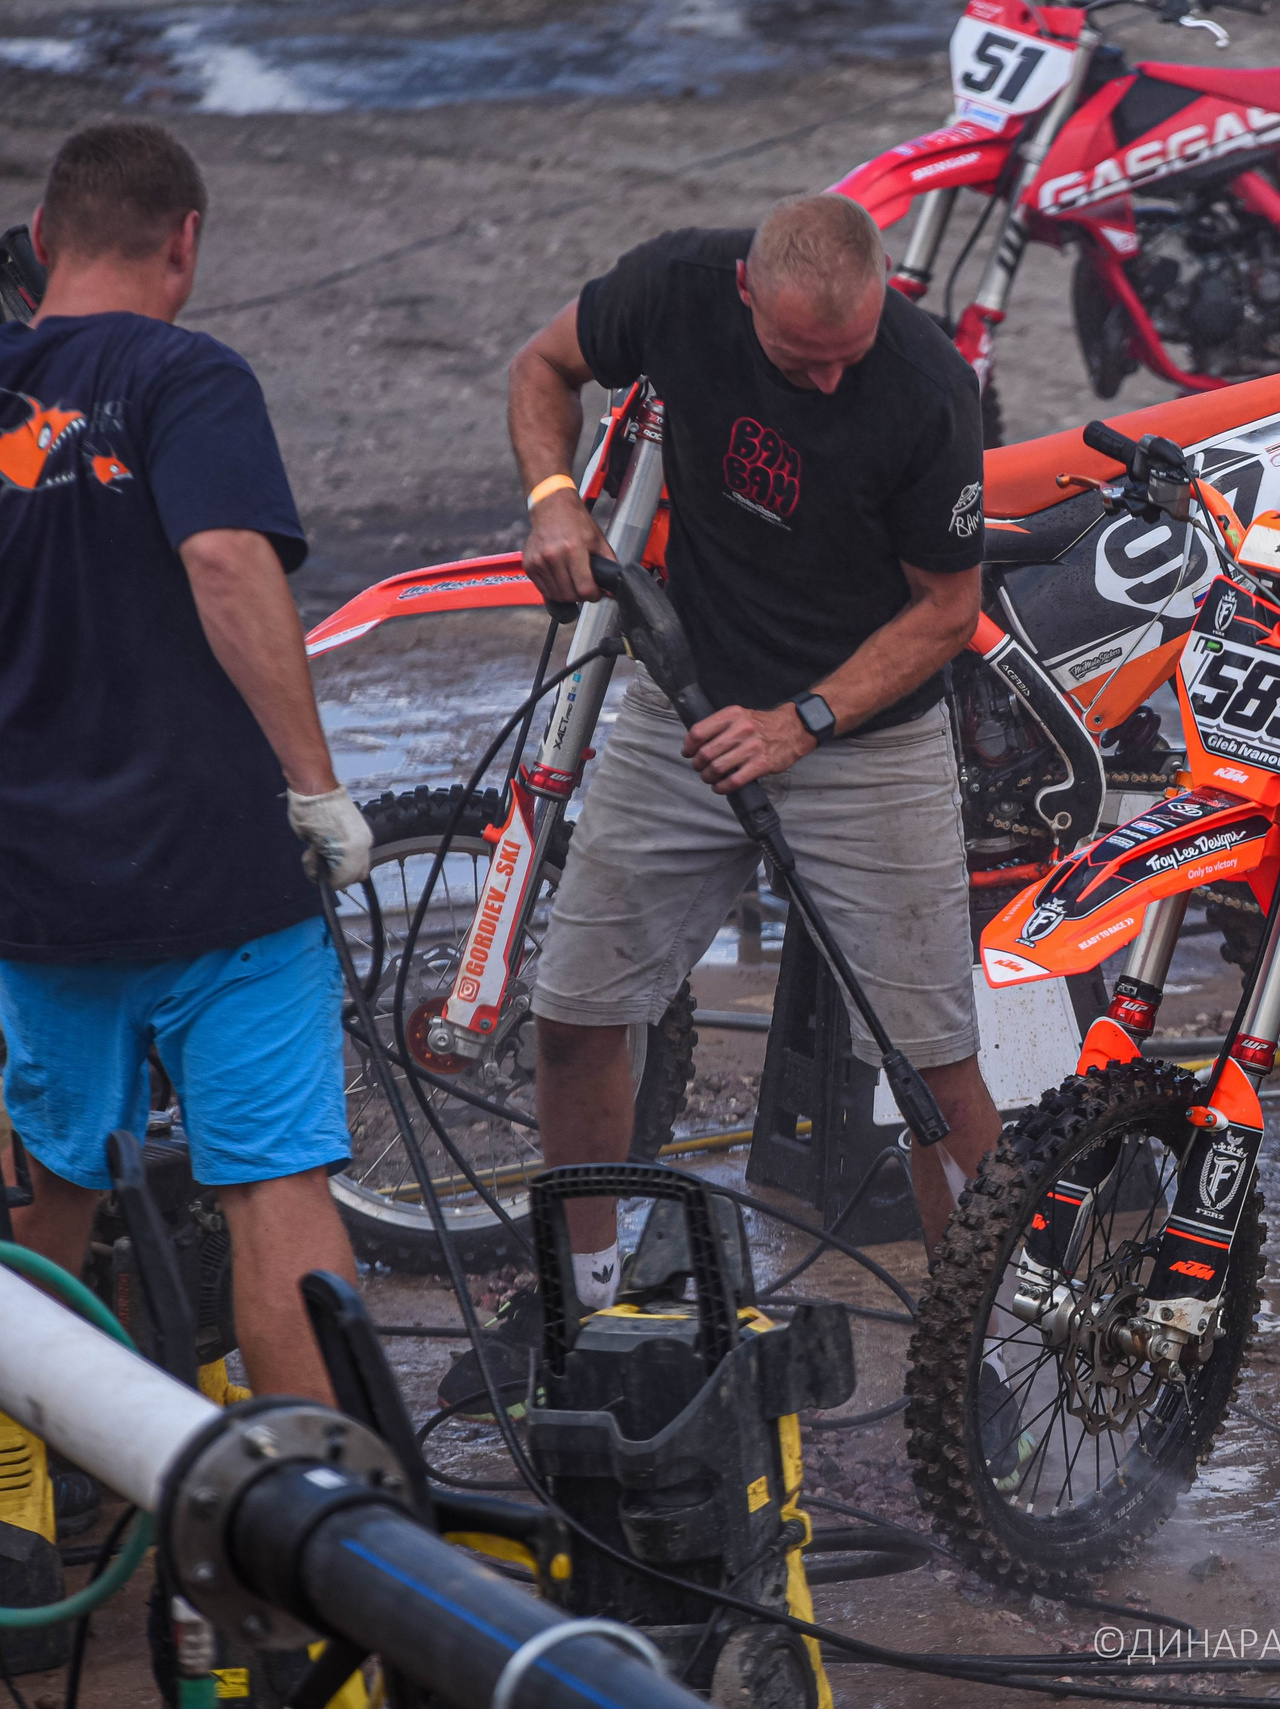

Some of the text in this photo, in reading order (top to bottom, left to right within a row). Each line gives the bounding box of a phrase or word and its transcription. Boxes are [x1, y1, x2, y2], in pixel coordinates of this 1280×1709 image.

[961, 31, 1047, 105] 51
[728, 416, 802, 473] BAM
[722, 452, 801, 518] BAM
[552, 716, 570, 751] XACT
[1206, 735, 1240, 753] Gleb
[1213, 767, 1249, 784] KTM
[1145, 830, 1247, 872] Troy Lee Designs
[1187, 857, 1238, 880] Only to victory
[465, 839, 522, 977] GORDIEV_SKI
[993, 958, 1025, 973] KTM
[1121, 1000, 1149, 1012] WP
[1241, 1039, 1269, 1051] WP
[1169, 1260, 1216, 1281] KTM
